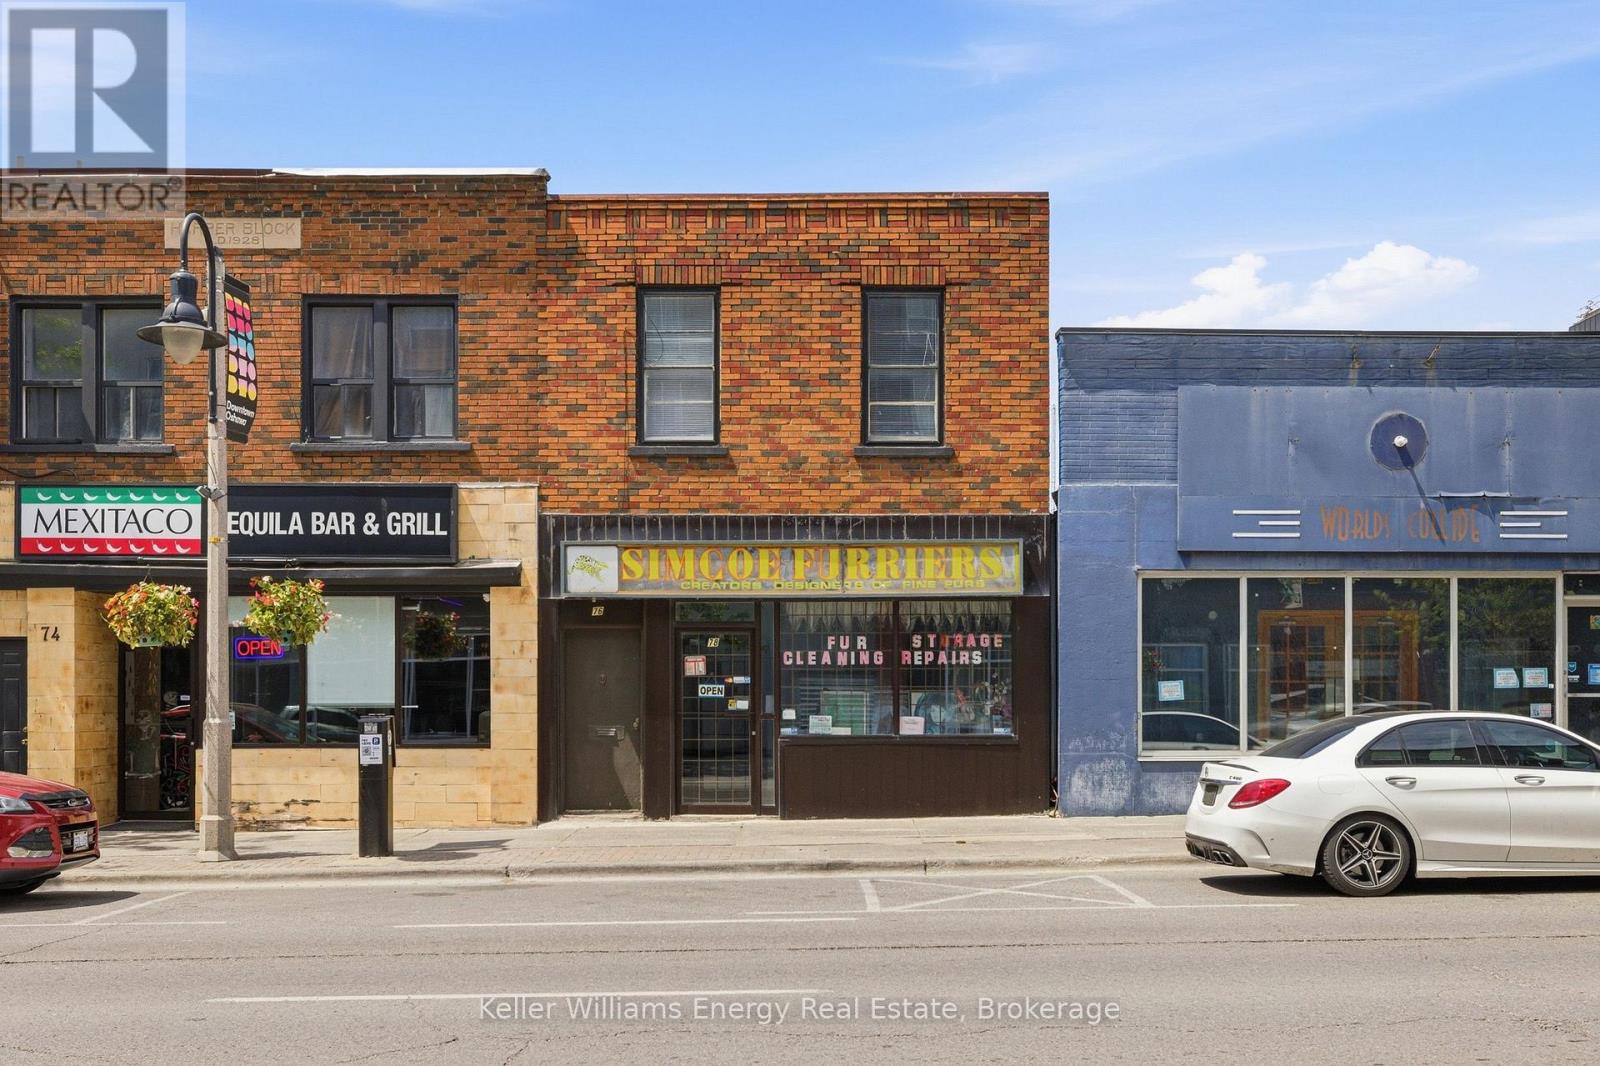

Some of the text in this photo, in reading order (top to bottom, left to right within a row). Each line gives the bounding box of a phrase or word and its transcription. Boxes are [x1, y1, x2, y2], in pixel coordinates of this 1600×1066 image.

[243, 223, 296, 235] BLOCK
[227, 400, 255, 418] Downtown
[33, 508, 193, 535] MEXITACO
[227, 511, 448, 537] EQUILA BAR & GRILL
[620, 546, 1005, 581] SIMCOE FURRIERS
[680, 580, 763, 590] CREATORS
[902, 580, 937, 589] FINE
[944, 579, 986, 589] FURS
[41, 626, 60, 641] 74
[827, 633, 1003, 650] FUR STORAGE
[237, 640, 282, 656] OPEN
[782, 650, 983, 666] CLEANING REPAIRS
[699, 686, 724, 696] OPEN
